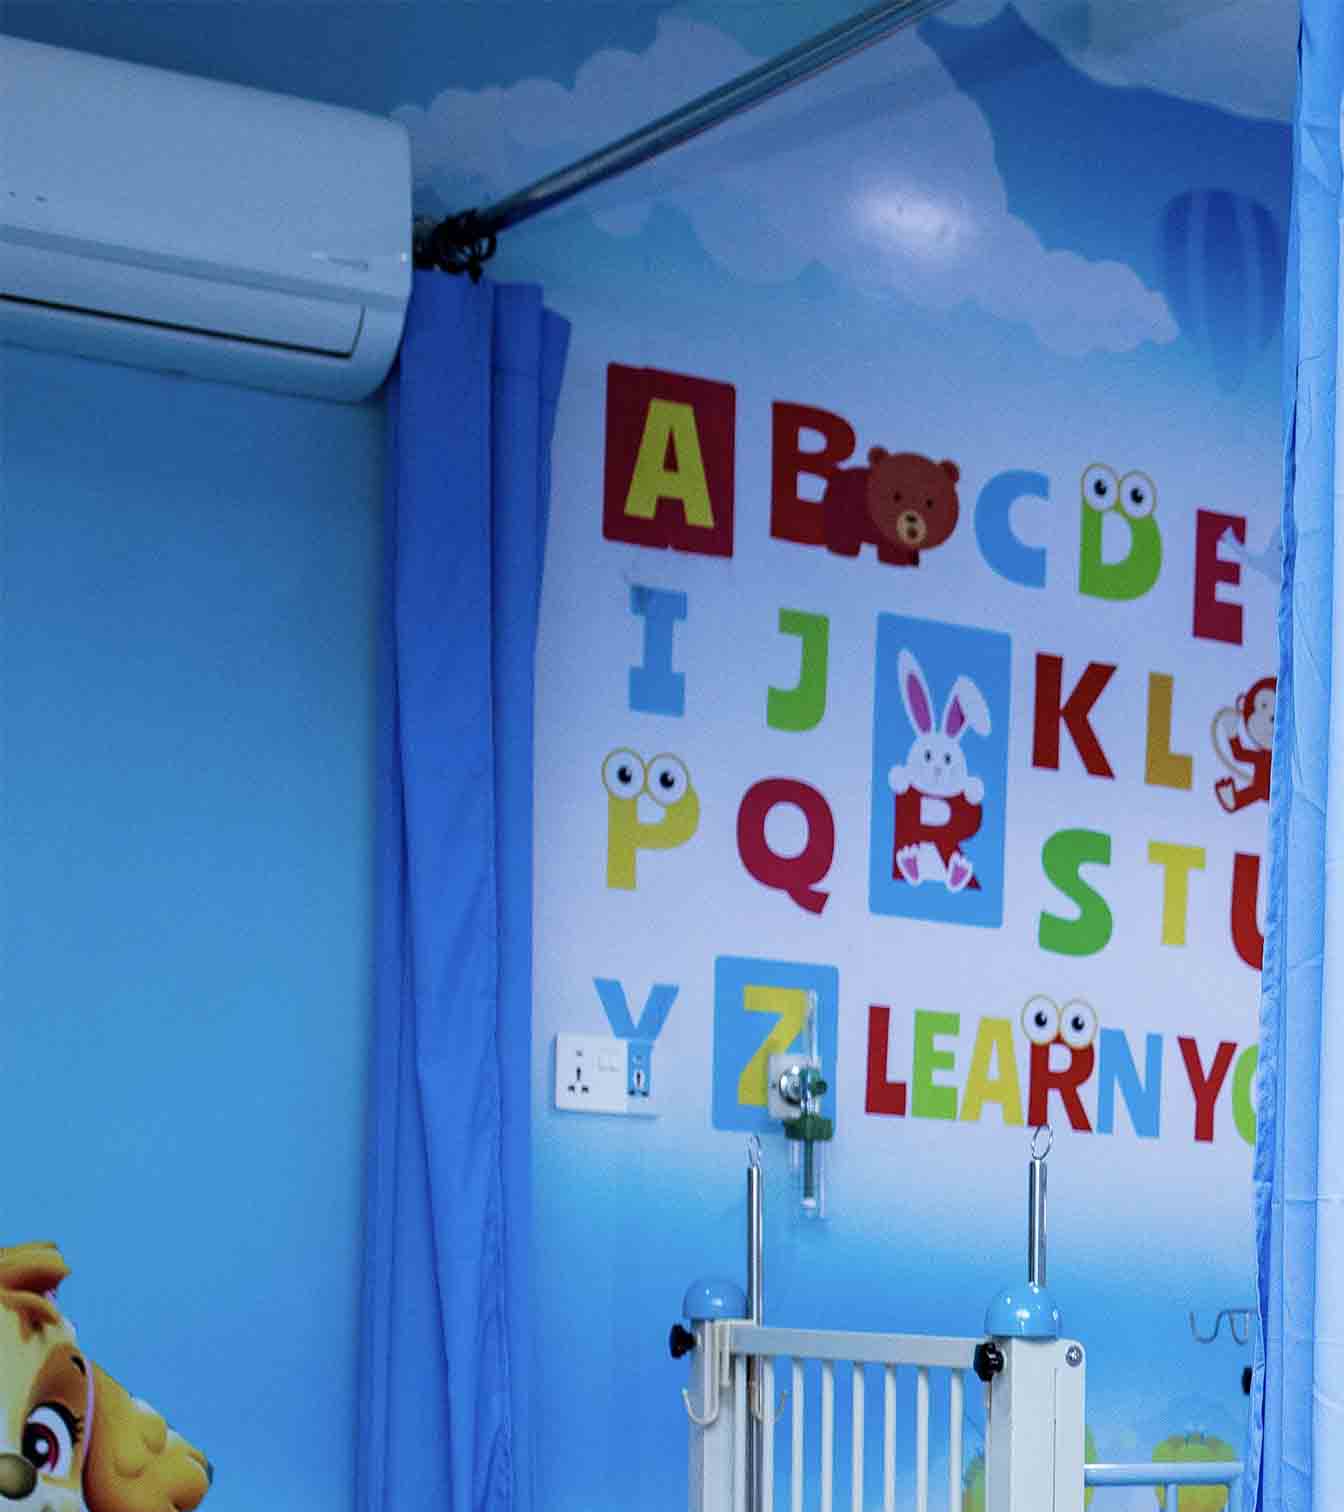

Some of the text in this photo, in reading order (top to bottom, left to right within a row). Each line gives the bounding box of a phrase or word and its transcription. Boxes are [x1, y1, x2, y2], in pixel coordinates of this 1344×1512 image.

[623, 397, 715, 530] A
[770, 400, 858, 547] B
[973, 469, 1050, 589] C
[1077, 476, 1163, 602] D
[1192, 507, 1248, 646] E
[628, 583, 688, 718] I
[766, 607, 830, 733] J
[1032, 652, 1118, 781] K
[1145, 671, 1193, 791] L
[605, 776, 700, 891] P
[736, 777, 836, 914] Q
[892, 780, 984, 891] R
[1037, 828, 1113, 957] S
[1147, 841, 1206, 945] T
[593, 977, 814, 1107] Y Z
[865, 1003, 1163, 1139] LEARN
